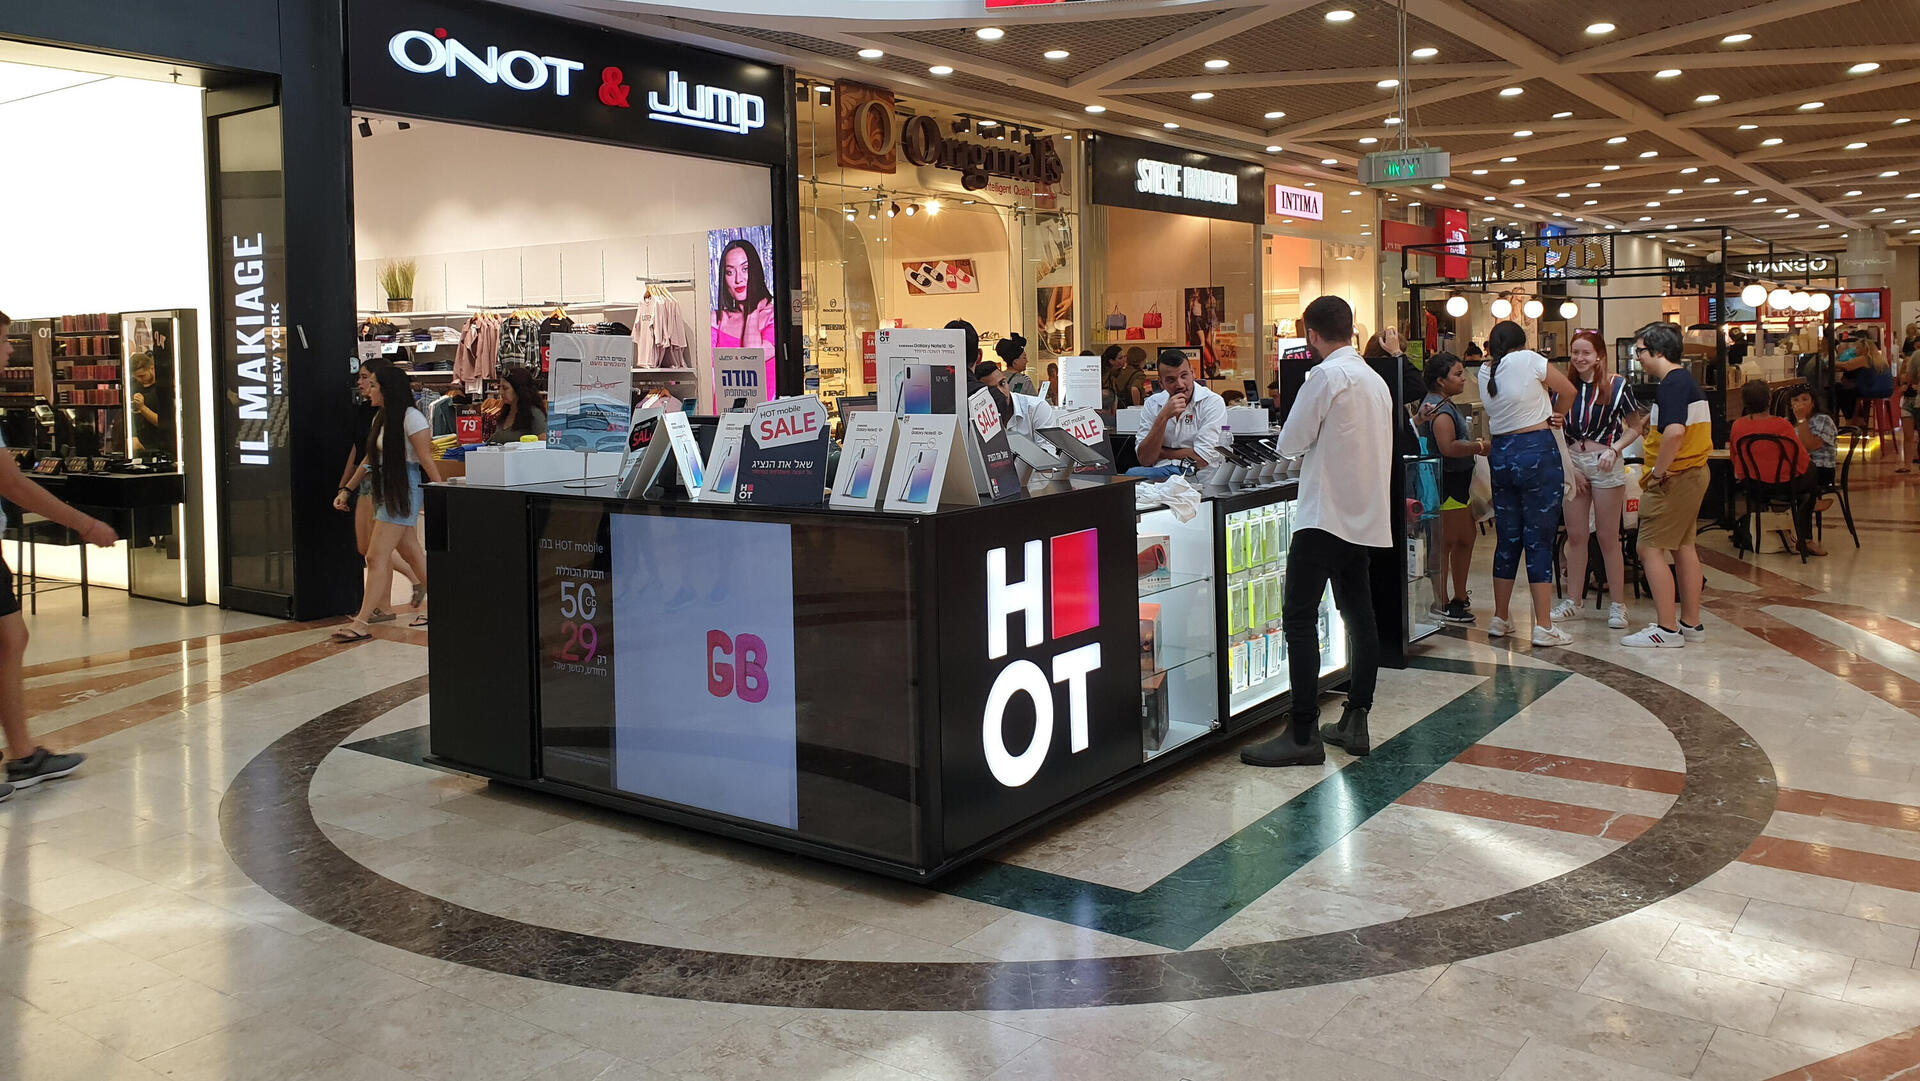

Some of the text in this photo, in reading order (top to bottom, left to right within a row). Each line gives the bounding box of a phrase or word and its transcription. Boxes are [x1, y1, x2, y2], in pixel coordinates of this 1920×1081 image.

[598, 66, 631, 108] &
[648, 70, 765, 135] Jump
[1135, 159, 1182, 196] STEVE
[1281, 191, 1319, 214] INTIMA
[1747, 258, 1828, 273] MANGO
[233, 232, 270, 466] IL MAKIAGE
[270, 302, 283, 395] NEW YORK
[721, 369, 758, 387] תודה
[760, 409, 776, 419] HOT
[776, 405, 801, 416] mobile
[760, 411, 817, 441] SALE
[977, 403, 998, 435] SALE
[751, 459, 814, 469] שאל את הנציג
[555, 539, 574, 551] HOT
[575, 541, 604, 553] mobile
[706, 629, 770, 704] GB
